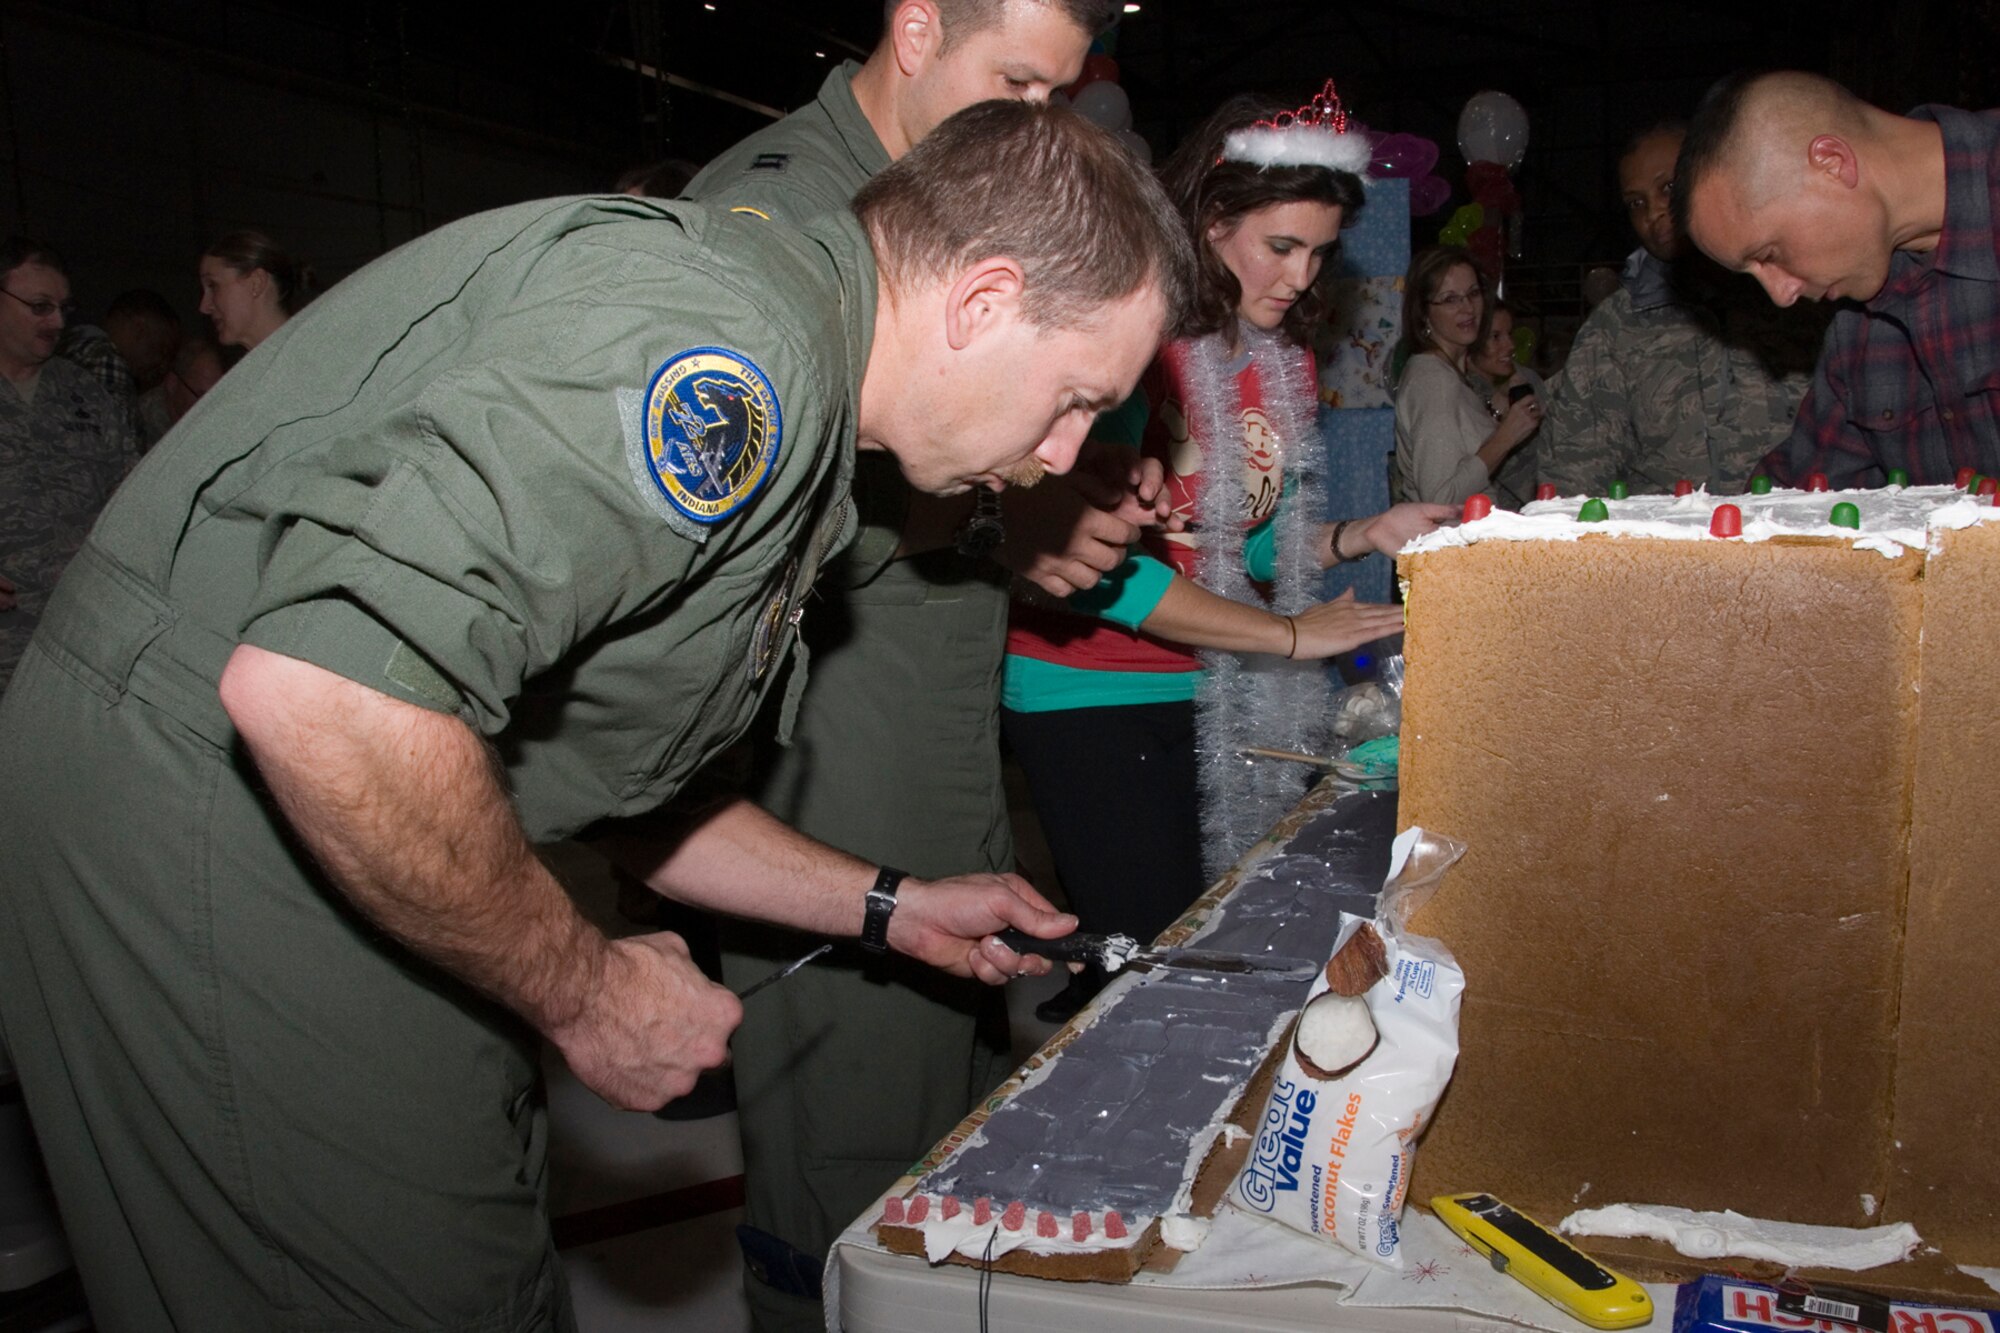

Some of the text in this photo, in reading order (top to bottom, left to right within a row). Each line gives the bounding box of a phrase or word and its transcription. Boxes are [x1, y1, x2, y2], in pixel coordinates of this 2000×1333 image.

[653, 364, 687, 409] GRISSOM
[740, 367, 761, 387] THE
[668, 402, 708, 440] 72
[677, 490, 720, 514] INDIANA
[1240, 1075, 1295, 1213] Great
[1275, 1089, 1316, 1191] Value
[1330, 1092, 1361, 1158] Flakes
[1383, 1155, 1399, 1209] Sweetened
[1732, 1291, 1985, 1333] CRH
